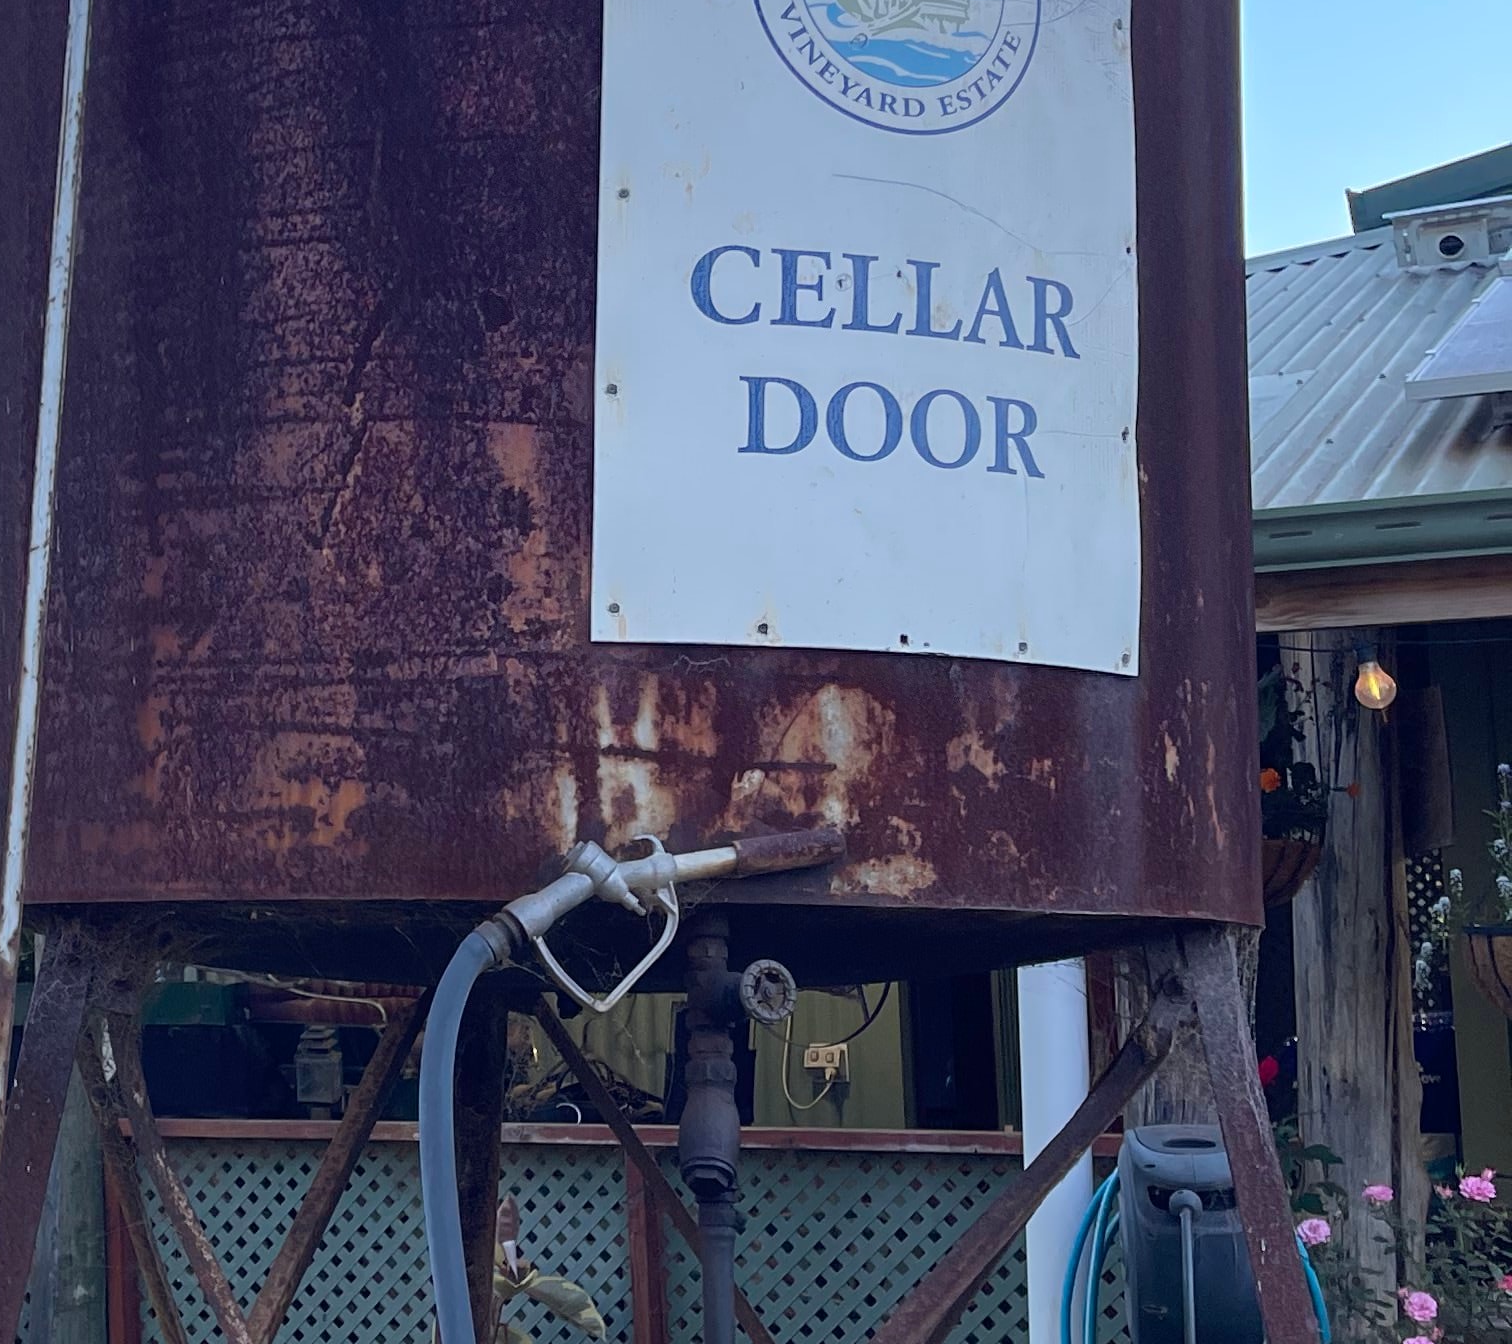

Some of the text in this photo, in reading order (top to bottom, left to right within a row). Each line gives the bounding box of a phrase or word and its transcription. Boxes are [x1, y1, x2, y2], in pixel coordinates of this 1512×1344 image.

[780, 0, 1021, 117] VINEYARD ESTATE
[690, 244, 1081, 360] CELLAR
[737, 375, 1045, 479] DOOR
